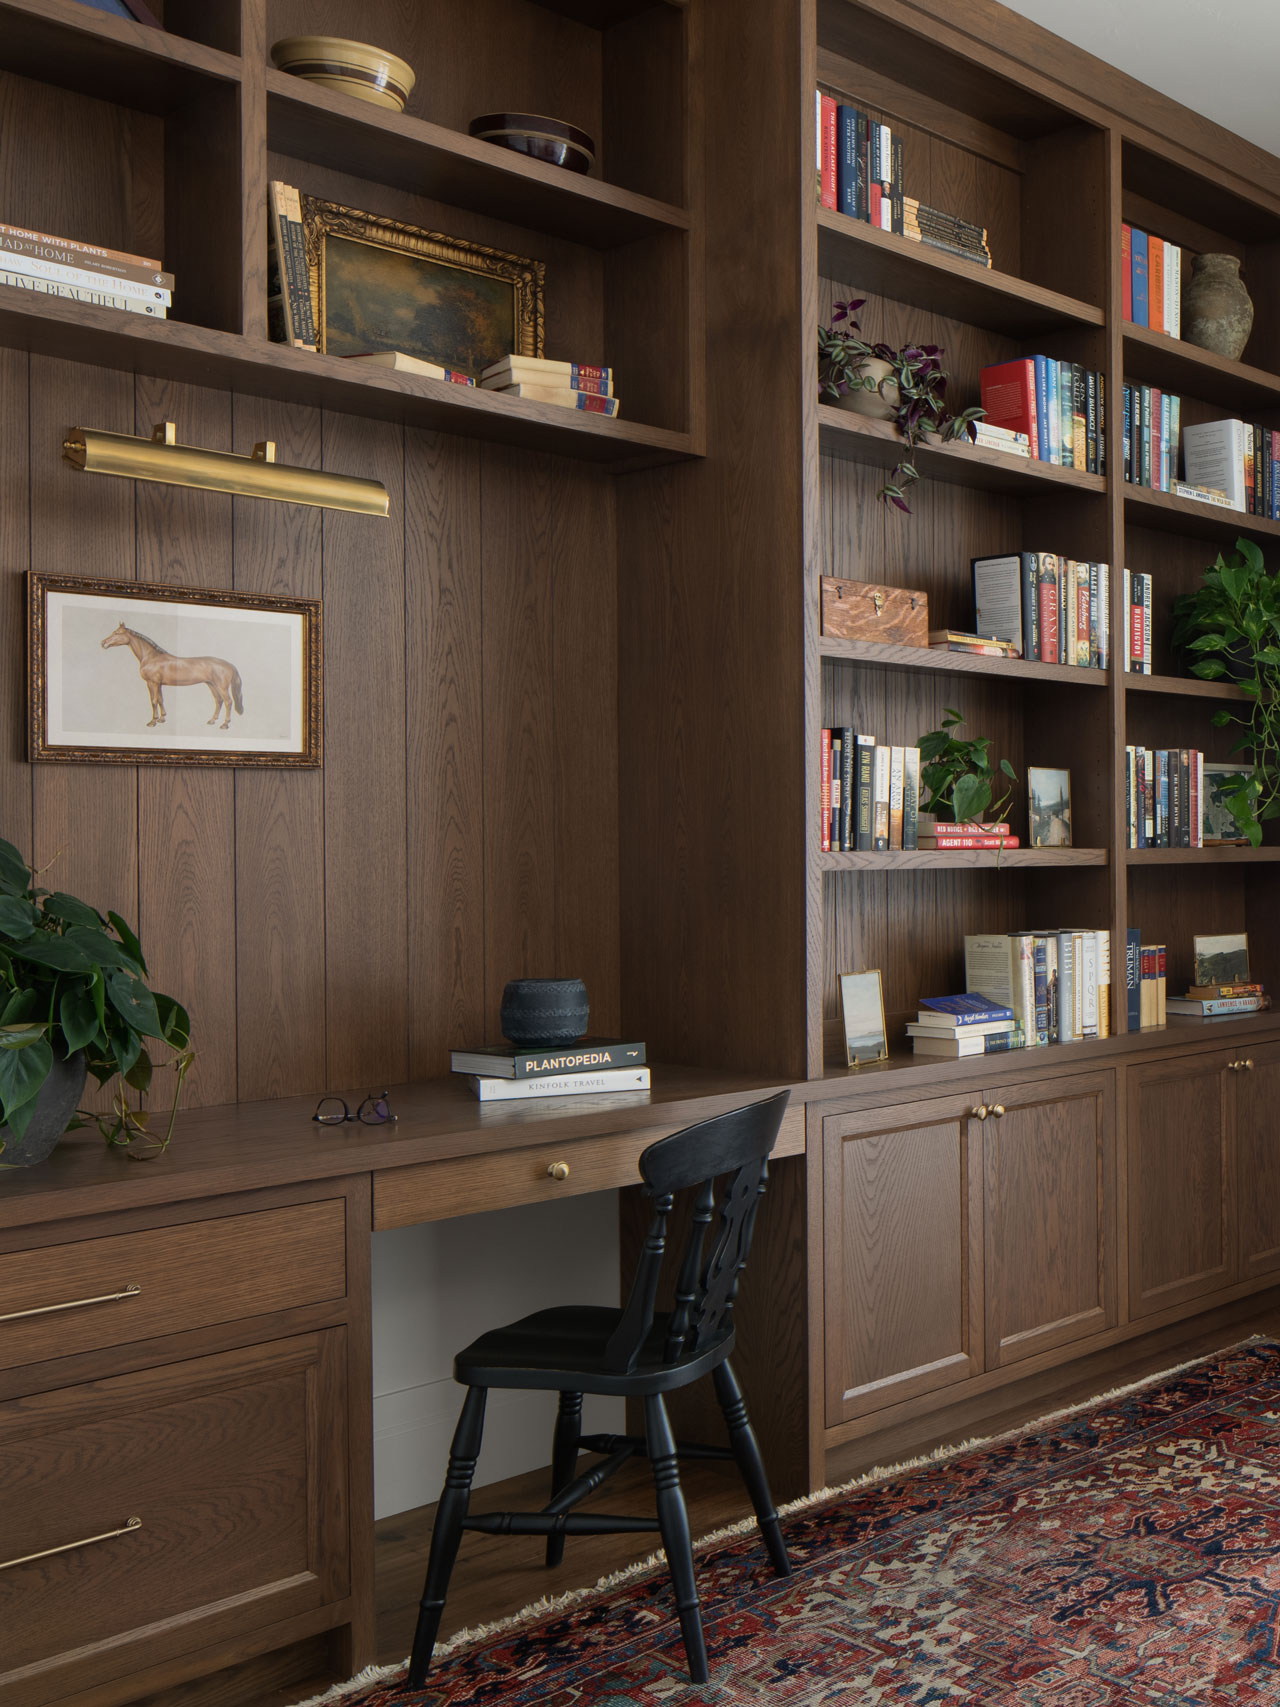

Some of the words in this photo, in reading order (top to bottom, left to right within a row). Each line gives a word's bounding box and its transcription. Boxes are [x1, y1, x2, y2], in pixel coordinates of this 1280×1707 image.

[10, 228, 39, 241] HOME
[42, 235, 68, 248] WITH
[70, 243, 107, 257] PLANTS
[25, 242, 34, 250] AT
[35, 245, 75, 264] HOME
[5, 275, 41, 292] LIVE
[46, 283, 132, 313] BEAUTIFUL
[1073, 372, 1081, 409] FOLLETT
[1088, 375, 1097, 397] DAVID
[1089, 398, 1097, 431] BALDACCI
[1090, 567, 1098, 594] VALLEY
[1049, 590, 1057, 645] GRANT
[1079, 590, 1089, 630] Vicksburg
[1133, 608, 1142, 656] WASHINGTON
[861, 750, 870, 764] AYN
[861, 765, 871, 783] RAND
[891, 767, 897, 780] AT
[896, 769, 902, 781] AN
[862, 789, 870, 805] ATLAS
[910, 811, 917, 823] OF
[942, 838, 962, 847] AGENT
[962, 838, 973, 847] 110
[1064, 942, 1072, 975] BIBI
[1126, 942, 1135, 989] TRUMAN
[1216, 1000, 1238, 1009] LAWRENCE
[1243, 998, 1257, 1007] ARABIA
[525, 1051, 612, 1073] PLANTOPEDIA
[528, 1081, 570, 1091] KINFOLK
[573, 1078, 607, 1089] TRAVEL
